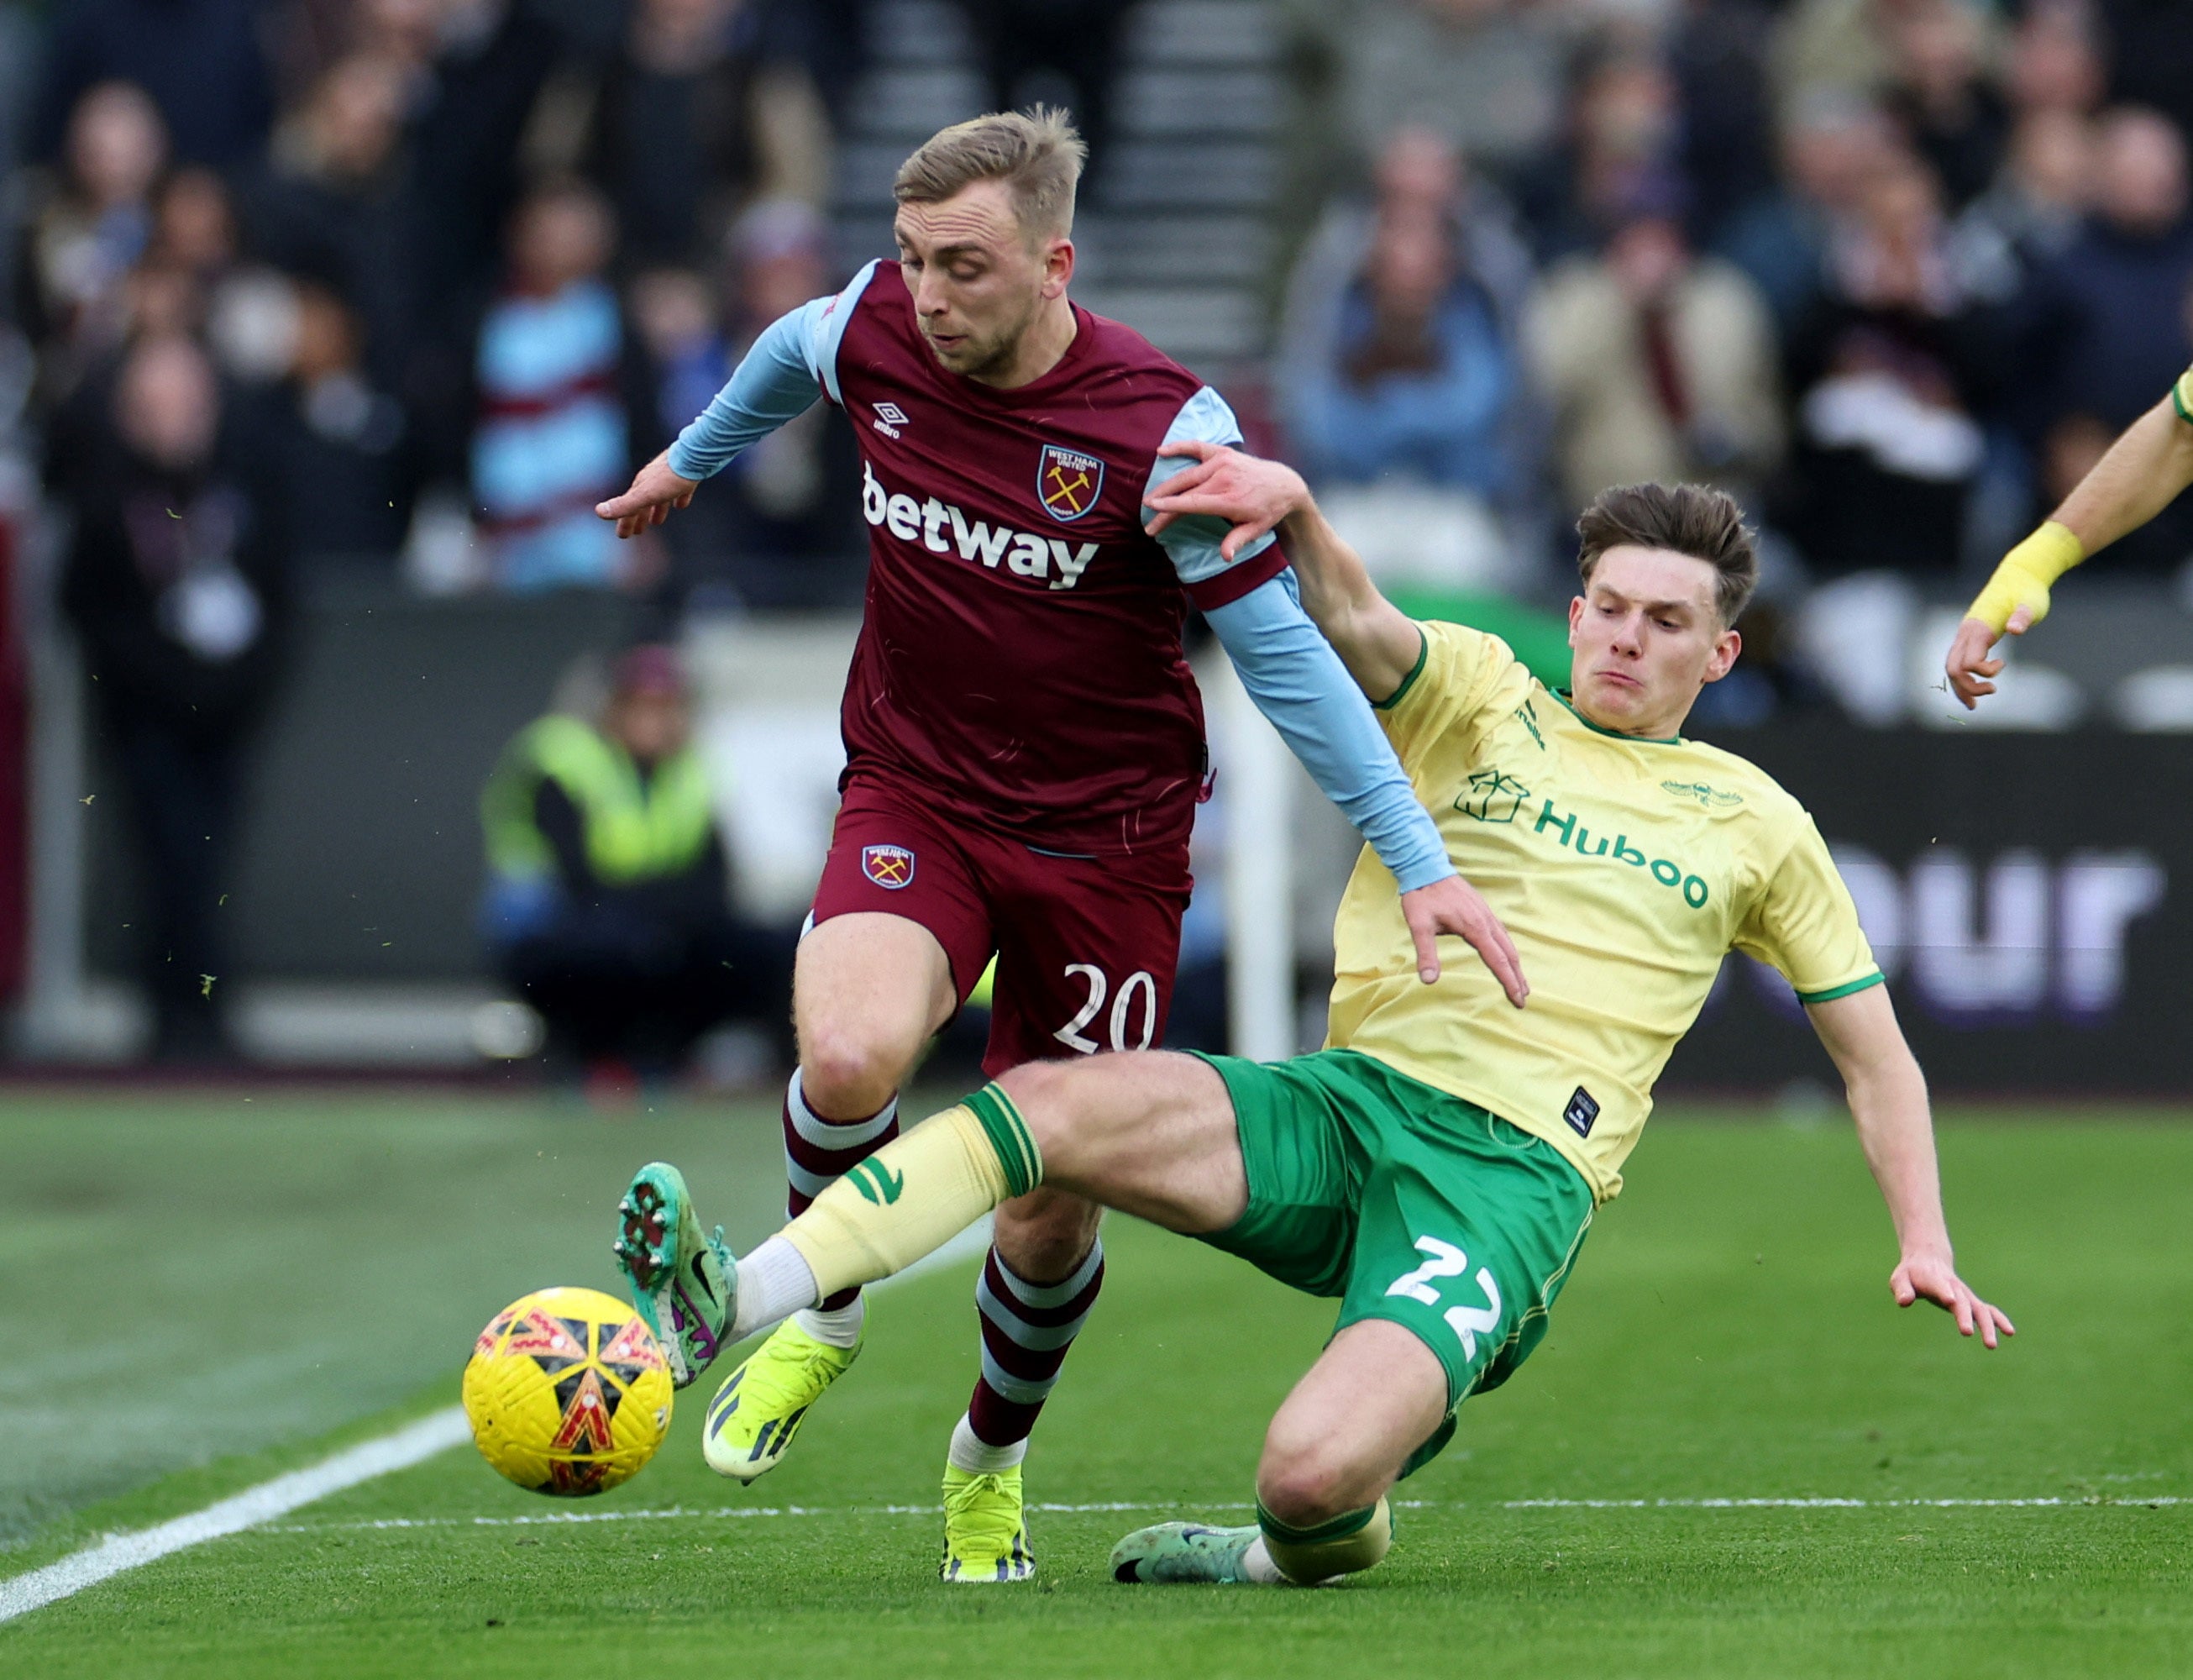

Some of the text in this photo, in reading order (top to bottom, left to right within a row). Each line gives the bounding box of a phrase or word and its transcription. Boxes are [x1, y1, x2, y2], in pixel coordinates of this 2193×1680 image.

[874, 419, 900, 439] umbro
[1048, 449, 1097, 470] WEST HAM
[1057, 459, 1086, 471] UNITED
[863, 459, 1100, 591] betway
[1534, 798, 1709, 909] Huboo
[1052, 963, 1156, 1054] 20
[1384, 1235, 1502, 1363] 22
